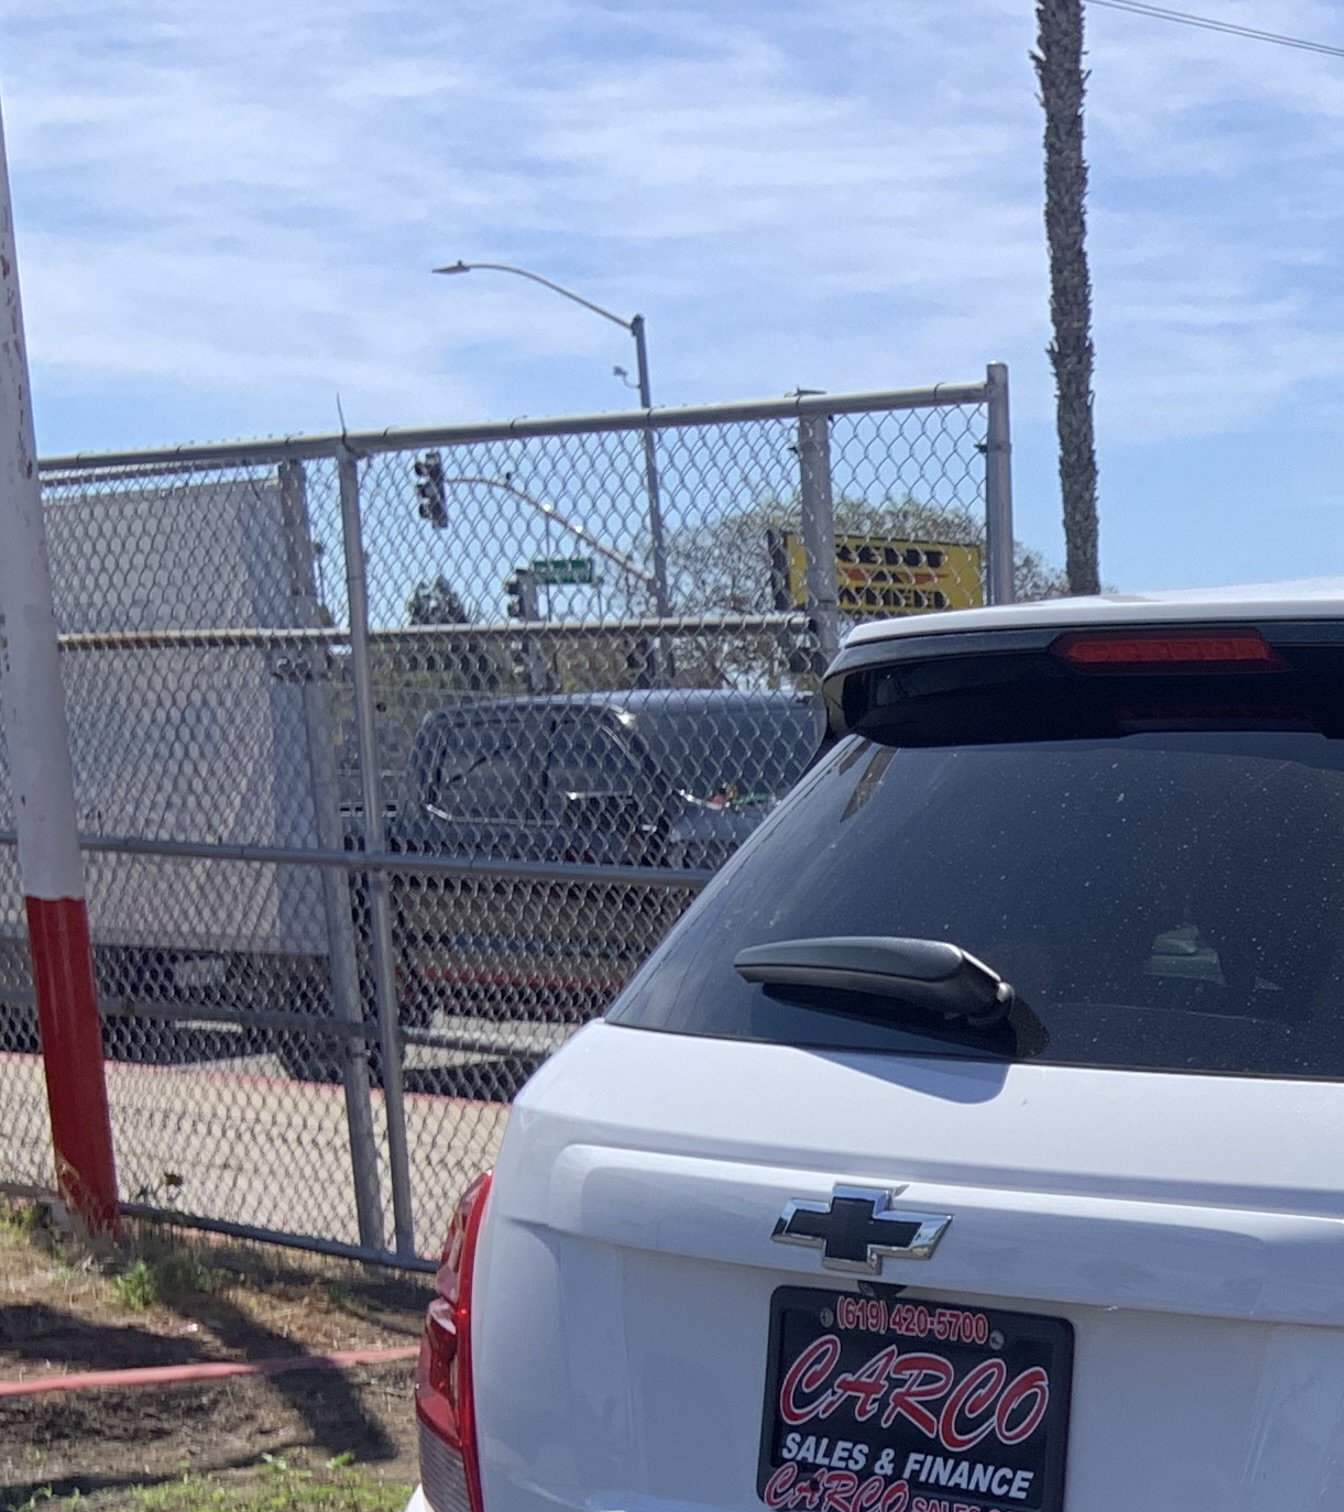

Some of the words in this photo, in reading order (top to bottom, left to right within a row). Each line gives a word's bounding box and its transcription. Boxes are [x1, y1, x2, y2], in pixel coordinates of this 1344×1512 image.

[837, 1296, 888, 1334] (619)
[890, 1304, 989, 1344] 420-5700
[780, 1334, 1049, 1452] CARCO
[782, 1432, 869, 1471] SALES
[874, 1448, 896, 1477] &
[902, 1451, 1035, 1500] FINANCE
